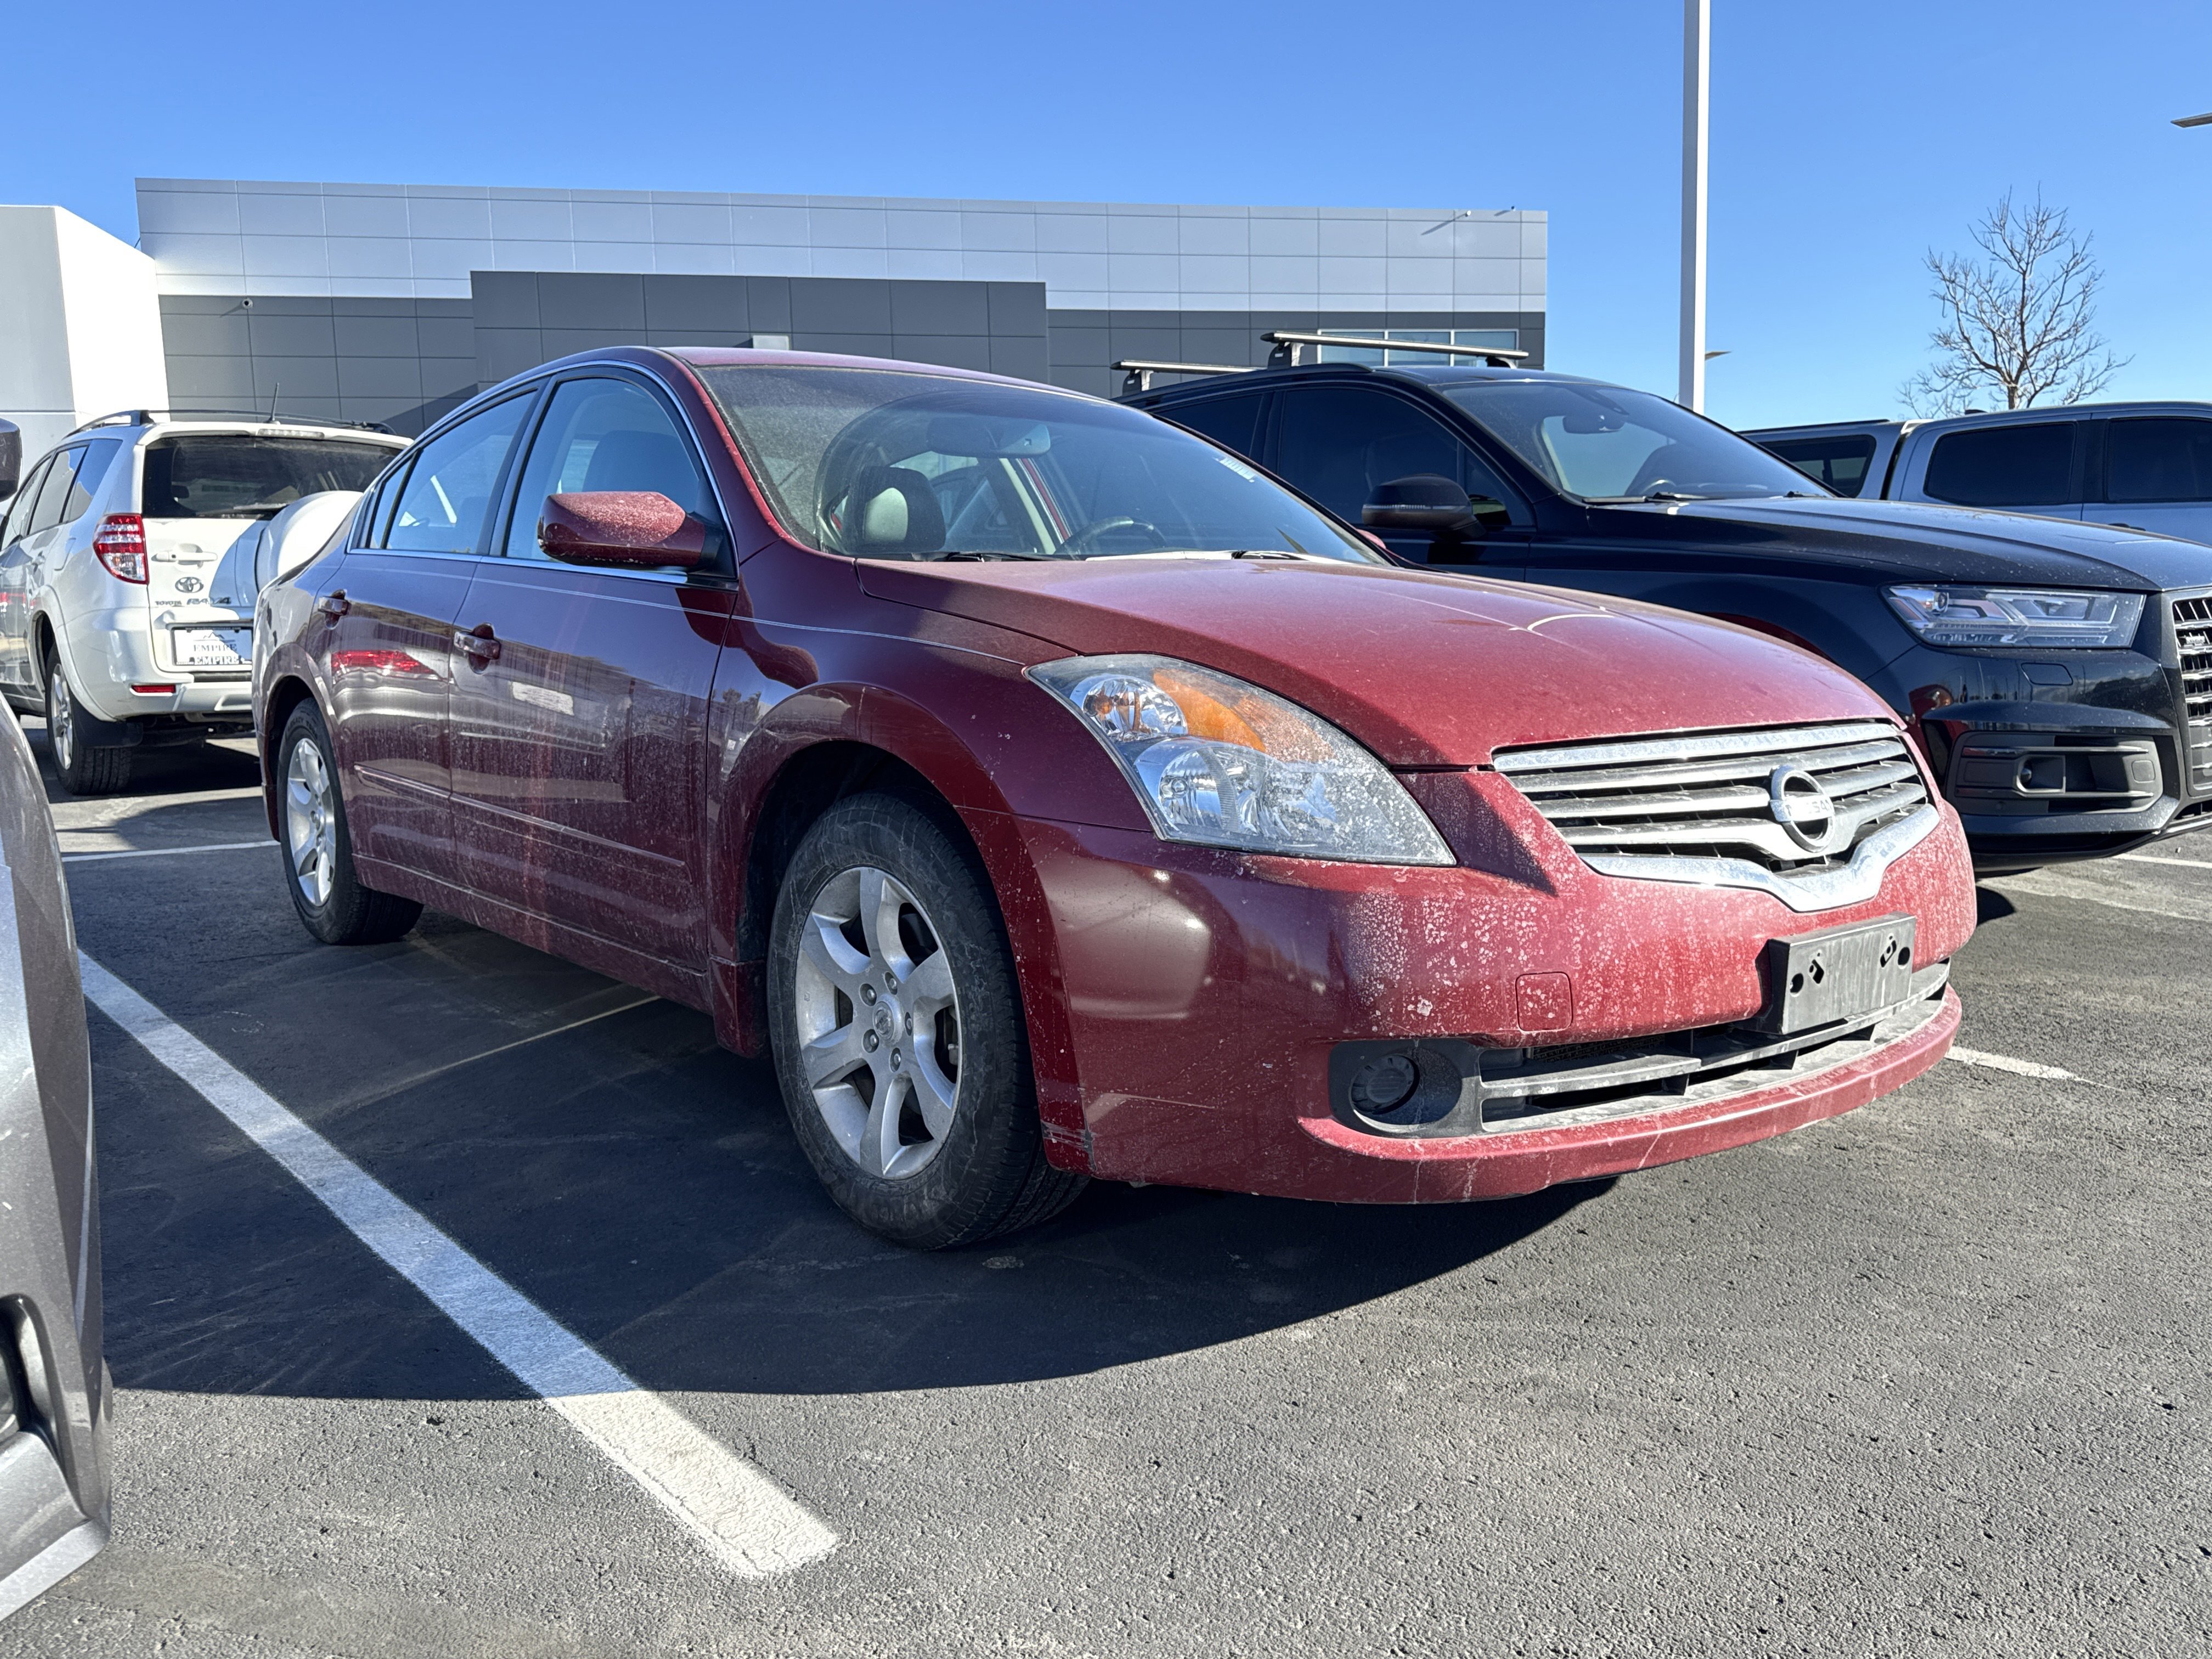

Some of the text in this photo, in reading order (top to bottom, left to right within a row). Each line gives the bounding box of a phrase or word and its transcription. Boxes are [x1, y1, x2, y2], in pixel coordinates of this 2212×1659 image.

[187, 597, 232, 605] RAV4
[193, 643, 238, 652] EMPIRE
[194, 656, 239, 665] EMPIRE
